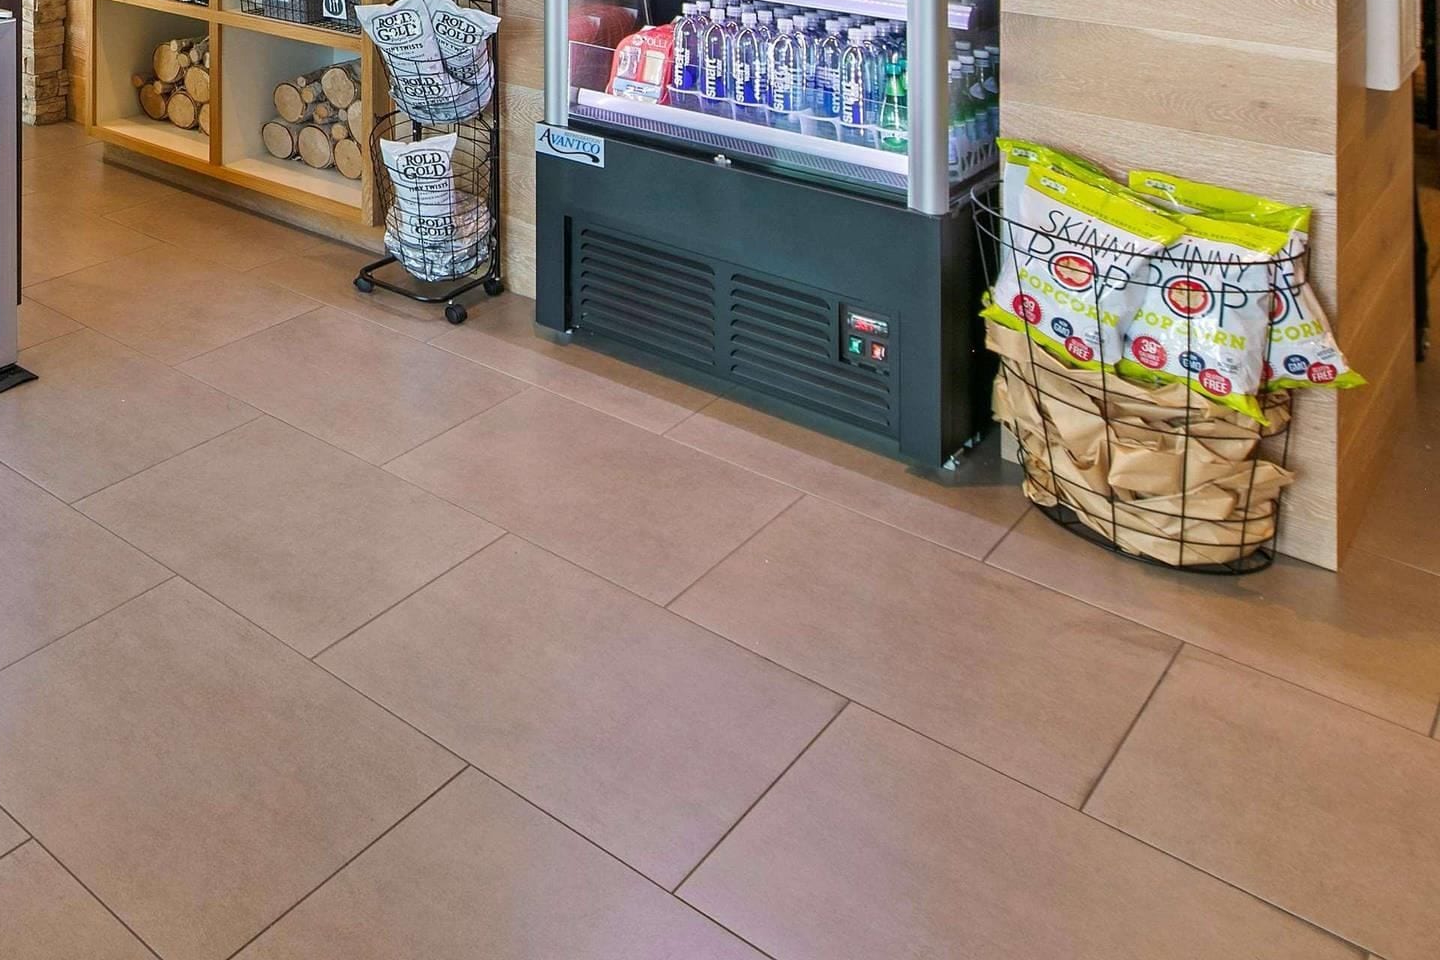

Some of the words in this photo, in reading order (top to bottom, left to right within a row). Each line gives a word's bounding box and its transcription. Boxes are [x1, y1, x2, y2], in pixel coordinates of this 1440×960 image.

[379, 12, 412, 28] ROLD
[441, 14, 477, 34] ROLD
[378, 23, 417, 41] GOLD
[436, 23, 477, 45] GOLD
[400, 43, 424, 51] TWISTS
[674, 47, 684, 86] smart
[706, 58, 716, 98] smart
[735, 62, 745, 103] smart
[538, 128, 601, 160] AVANTCO
[405, 152, 442, 166] ROLD
[404, 163, 447, 180] GOLD
[426, 182, 448, 192] TWISTS
[1040, 210, 1148, 267] SKiNNY
[1026, 232, 1131, 301] POP
[1155, 242, 1255, 283] KiNNY
[1019, 267, 1120, 328] POPCORN
[1271, 320, 1324, 343] CORN
[1068, 344, 1089, 361] FREE
[1287, 360, 1308, 373] GMO
[1312, 370, 1334, 382] FREE
[1203, 378, 1228, 395] FREE
